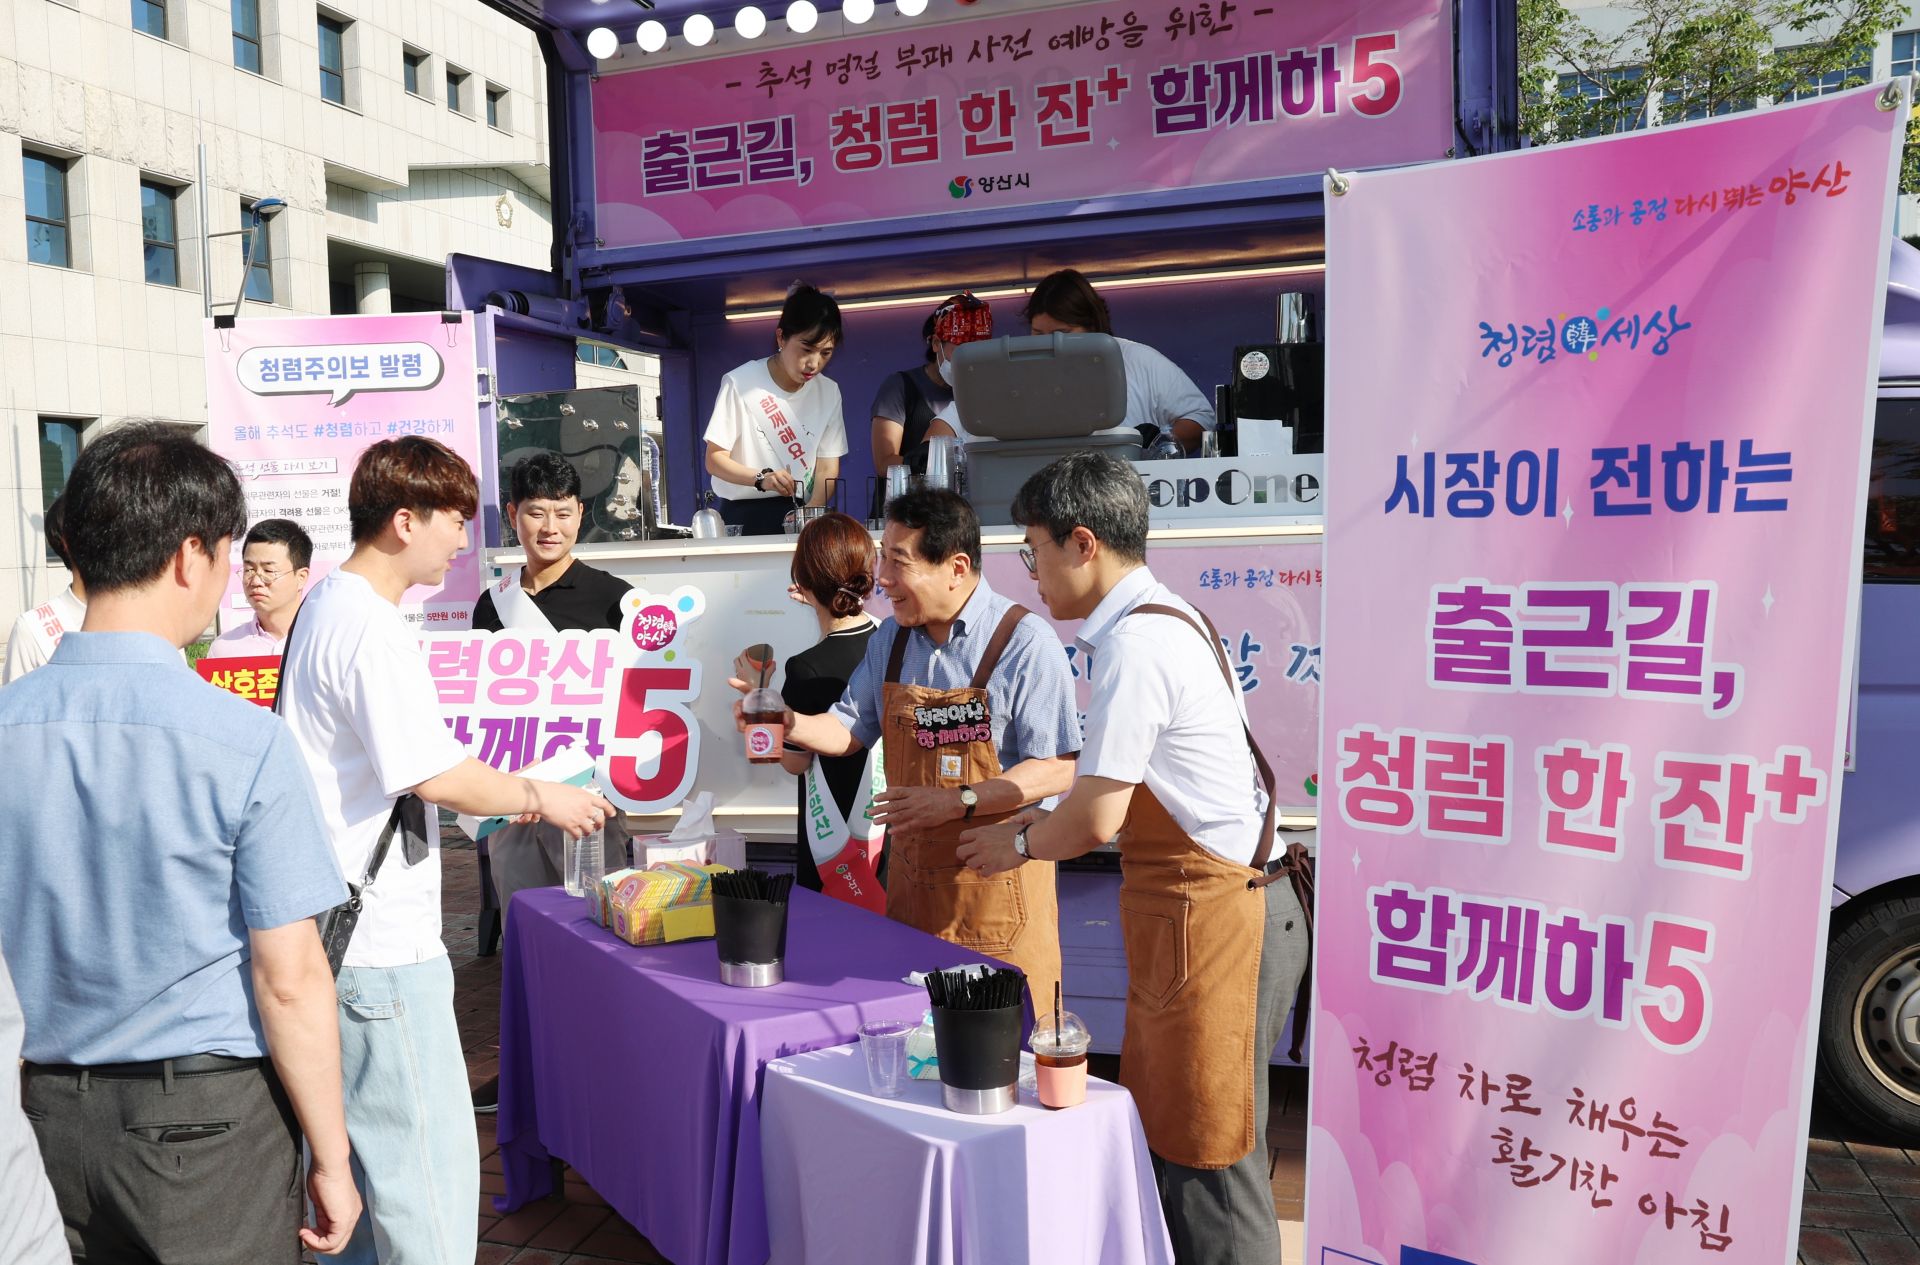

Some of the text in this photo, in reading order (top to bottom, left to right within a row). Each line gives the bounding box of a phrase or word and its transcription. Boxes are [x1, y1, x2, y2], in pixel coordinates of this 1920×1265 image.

[754, 59, 814, 98] 추석
[825, 50, 882, 86] 명절
[895, 42, 954, 77] 부패
[967, 28, 1034, 64] 사전
[1048, 10, 1149, 52] 예방을
[1164, 0, 1237, 42] 위한
[642, 115, 813, 196] 출근길,
[830, 98, 940, 171] 청렴
[958, 88, 1017, 158] 한
[1150, 32, 1402, 135] 함께하5
[978, 172, 1031, 194] 양산시
[1571, 160, 1852, 233] 소통과 공정 다시 뛰는 양산
[259, 352, 423, 383] 청렴주의보 발령
[233, 418, 455, 441] 올해 추석도 #청렴하고 #건강하게
[759, 394, 809, 470] 함께해요!
[283, 461, 305, 472] 다시
[308, 460, 329, 471] 보기
[1383, 438, 1793, 518] 시장이 전하는
[279, 507, 303, 517] 격려용
[321, 488, 342, 498] 거절!
[313, 541, 346, 551] 자로부터
[1199, 568, 1240, 590] 소통과
[1243, 568, 1275, 588] 공정
[1278, 569, 1311, 587] 다시
[426, 611, 449, 622] 5만원
[451, 610, 468, 621] 이하
[636, 630, 668, 646] 양산
[418, 638, 614, 706] 렴양산
[1431, 584, 1737, 711] 출근길,
[210, 667, 279, 700] 상호존
[1341, 730, 1507, 838] 청렴
[1542, 746, 1627, 854] 한
[1372, 888, 1711, 1046] 함께하5
[1352, 1036, 1689, 1159] 청렴 차로 채우는
[1490, 1126, 1733, 1253] 활기찬 아침
